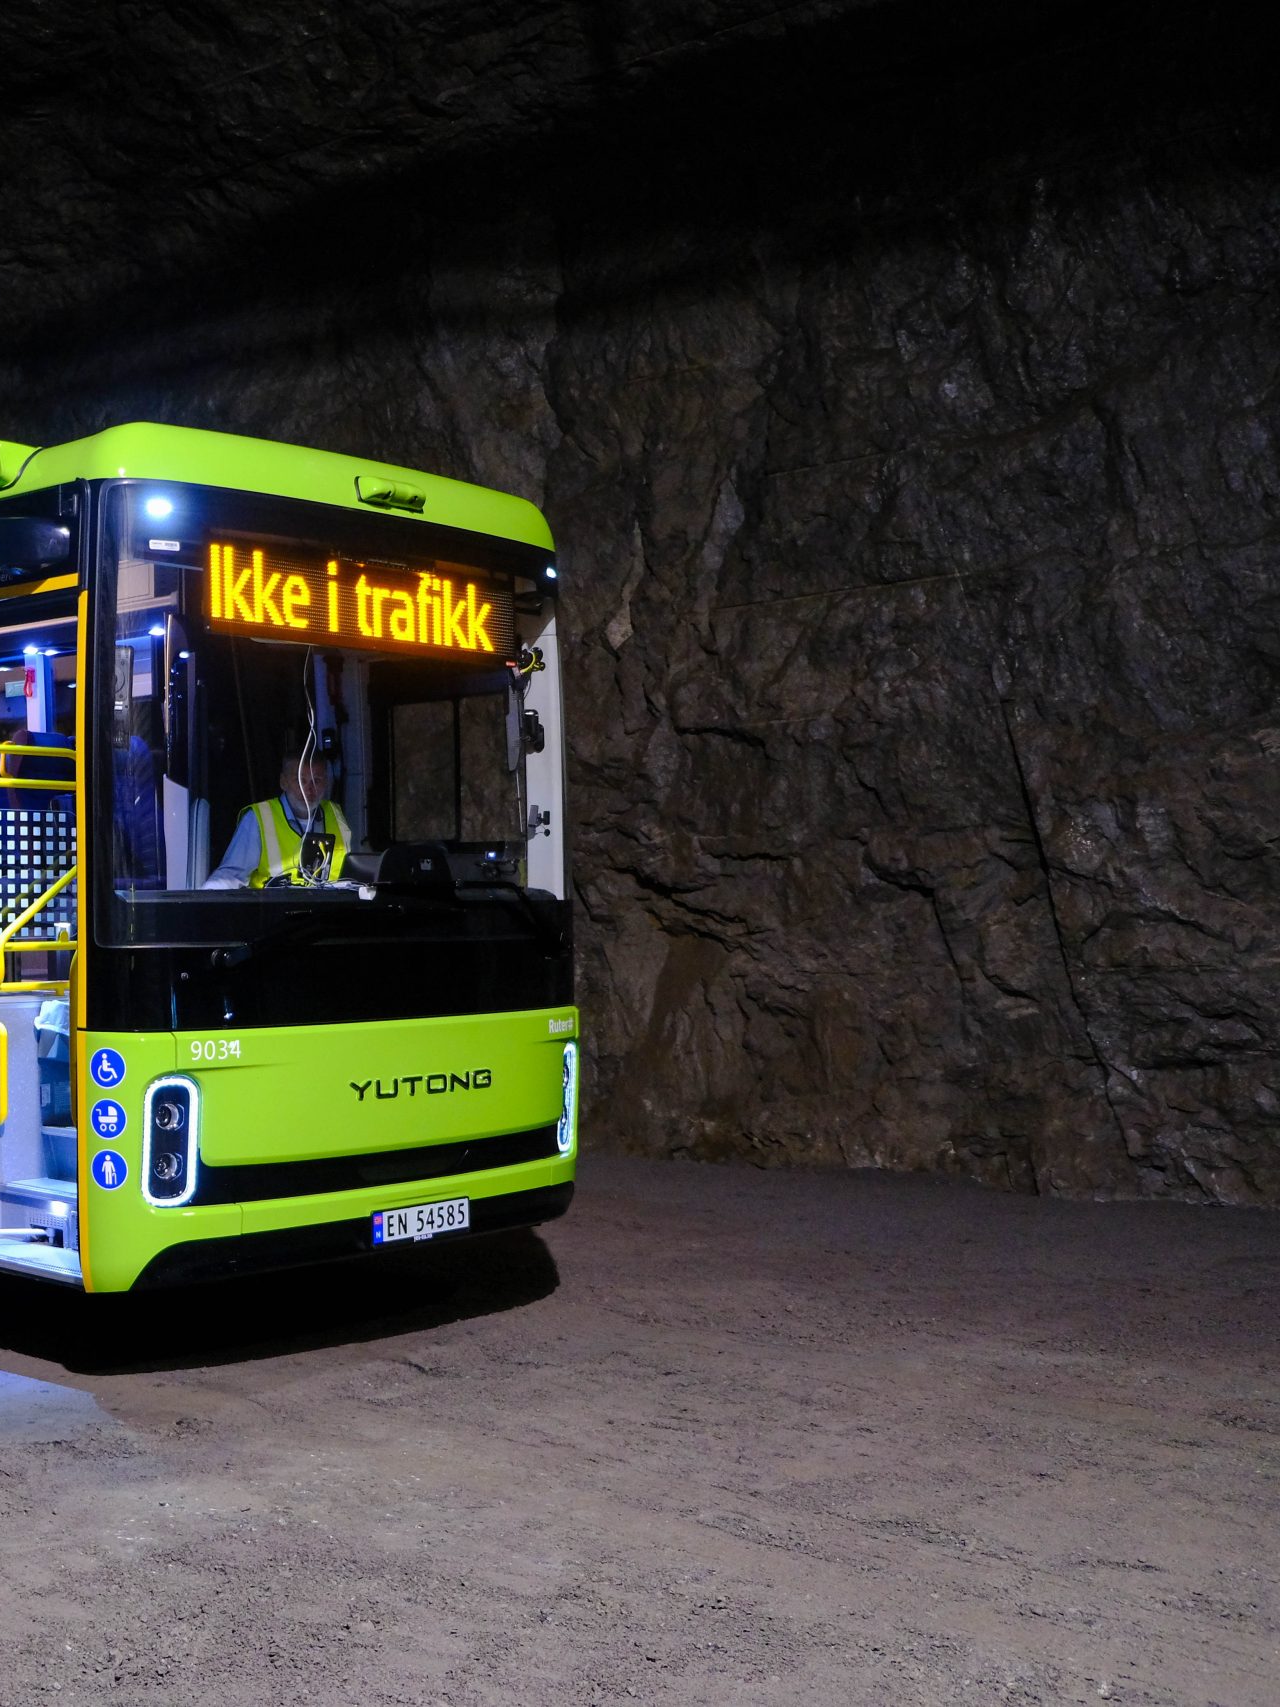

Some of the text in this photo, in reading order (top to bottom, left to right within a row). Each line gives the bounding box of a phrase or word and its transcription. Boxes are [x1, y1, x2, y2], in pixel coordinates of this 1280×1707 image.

[210, 544, 494, 651] Ikke i trafikk
[190, 1040, 241, 1061] 9034
[349, 1069, 492, 1101] YUTONG
[387, 1203, 465, 1237] EN 54585
